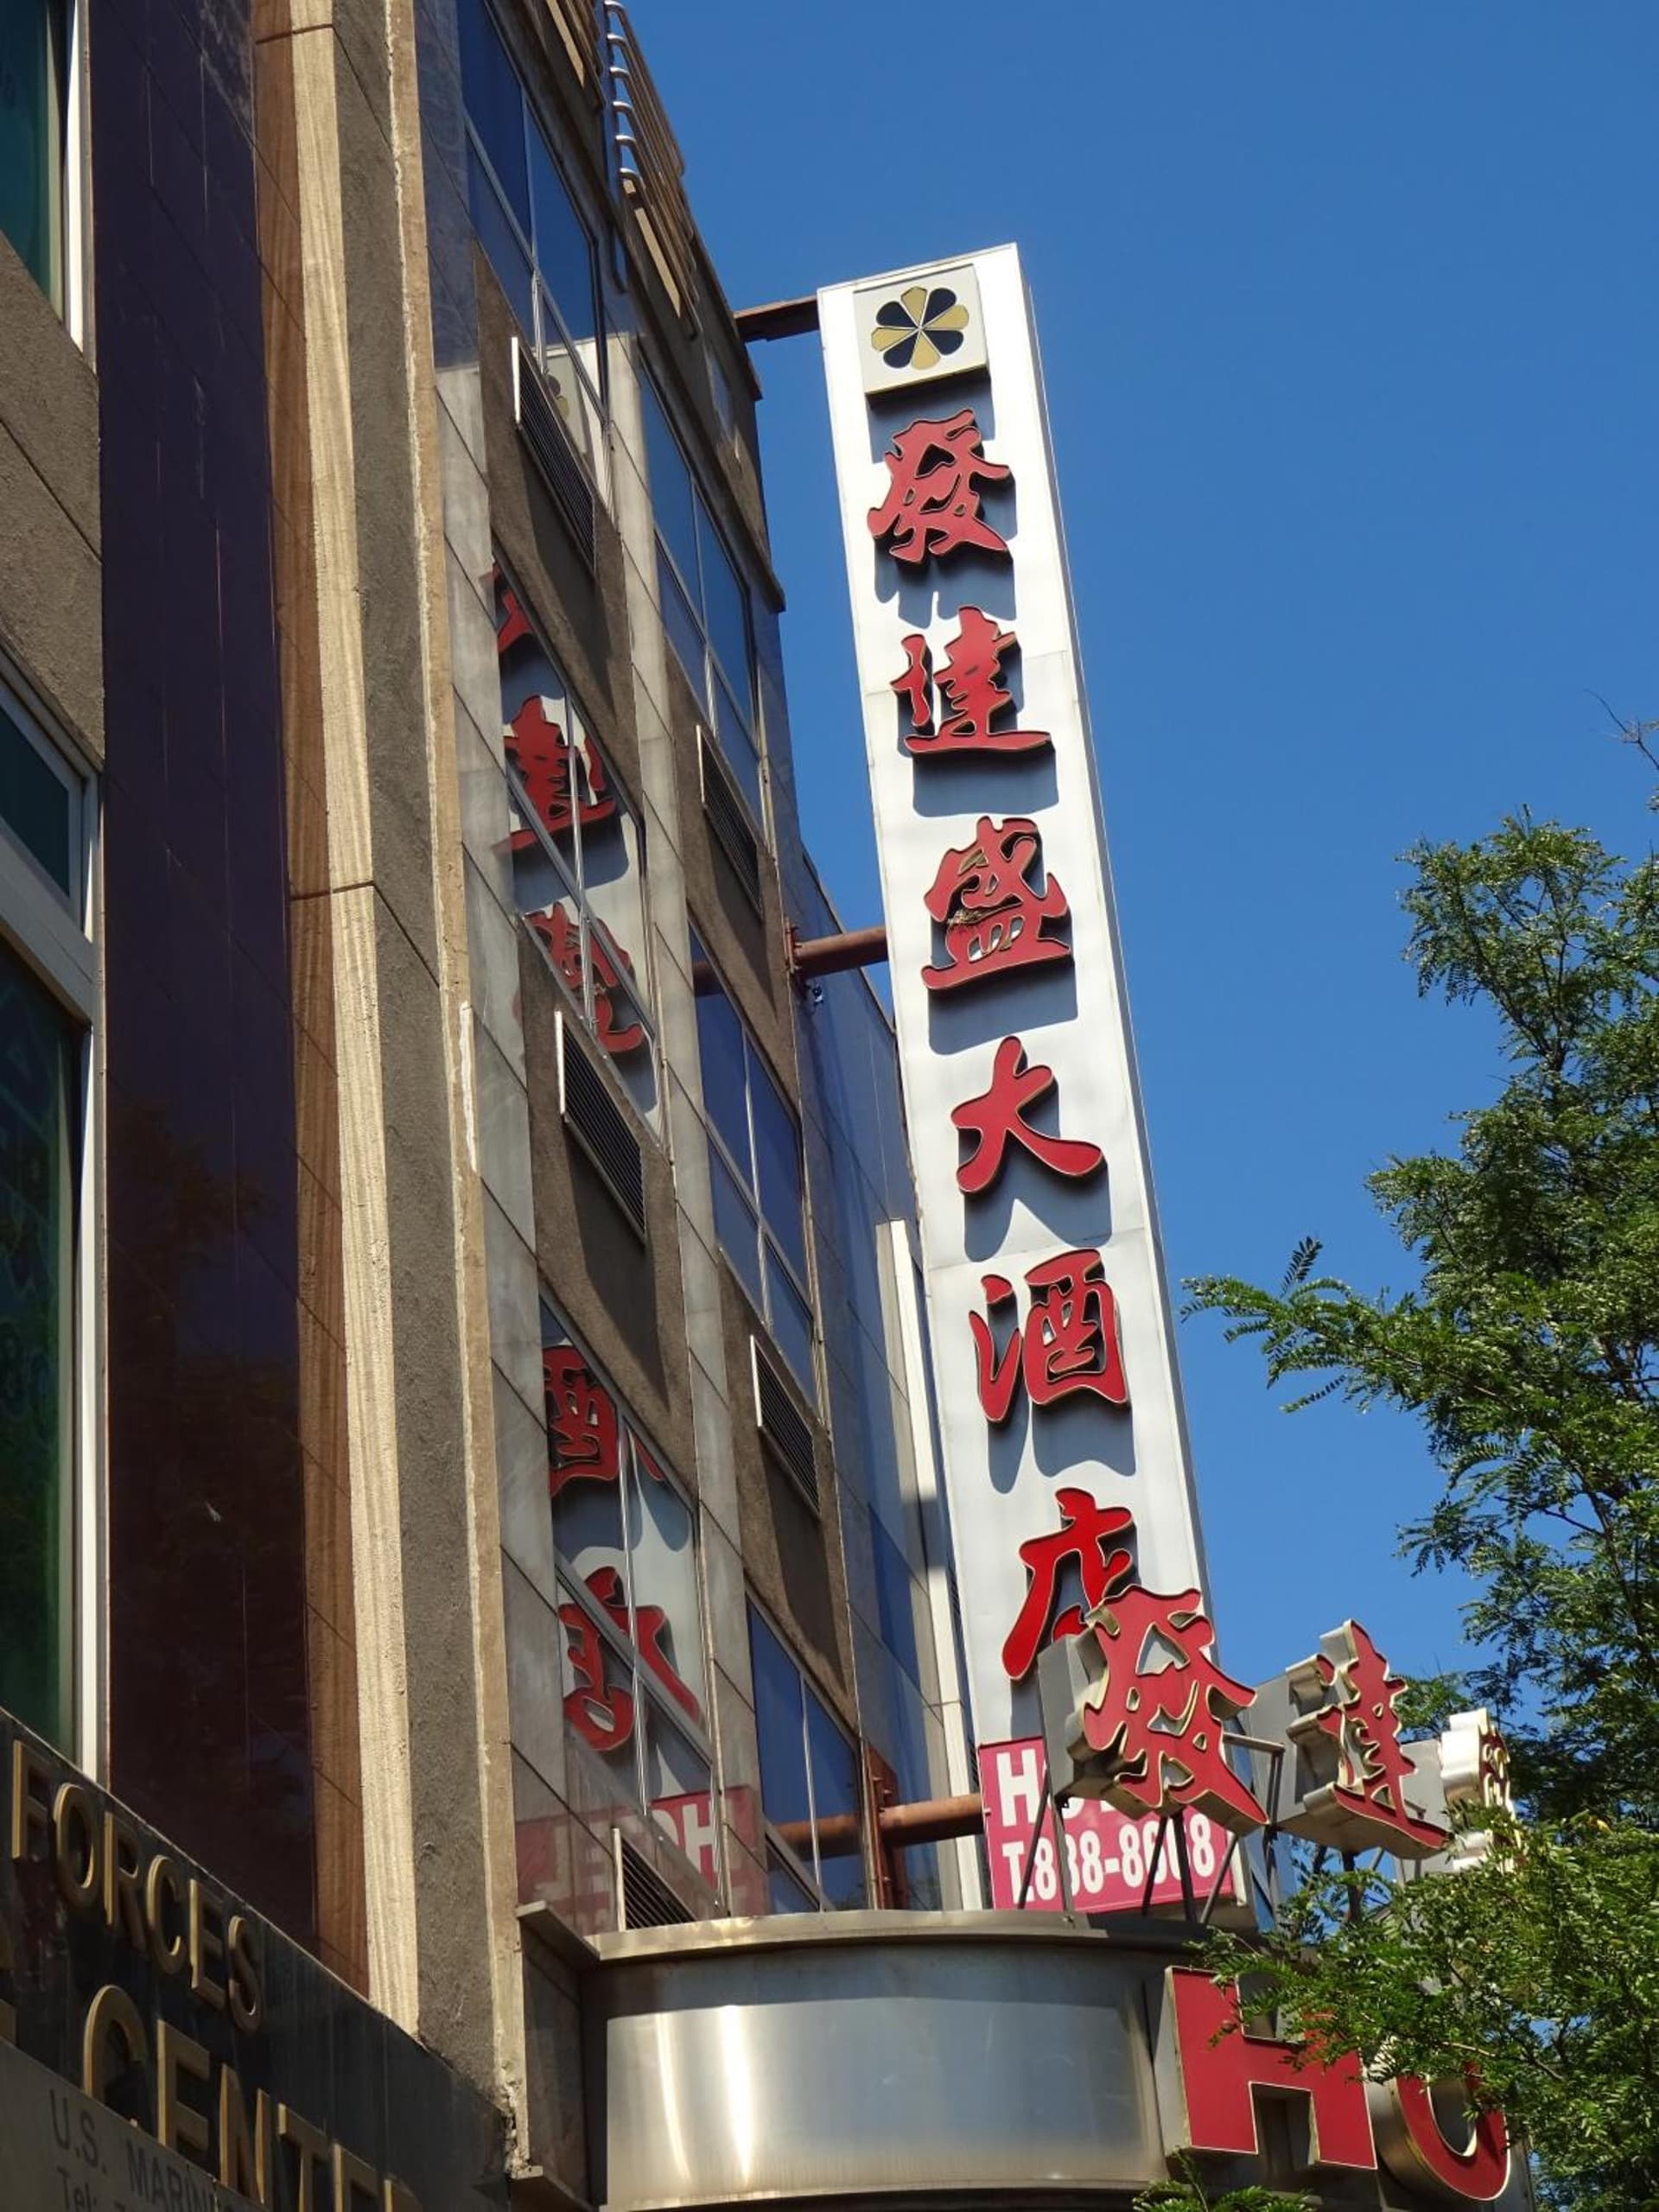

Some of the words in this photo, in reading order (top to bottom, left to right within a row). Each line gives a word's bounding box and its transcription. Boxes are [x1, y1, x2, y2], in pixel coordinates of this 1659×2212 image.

[11, 1738, 264, 2035] FORCES
[48, 2088, 107, 2175] U.S.
[126, 2139, 221, 2212] MARIN
[83, 1985, 421, 2212] CENT
